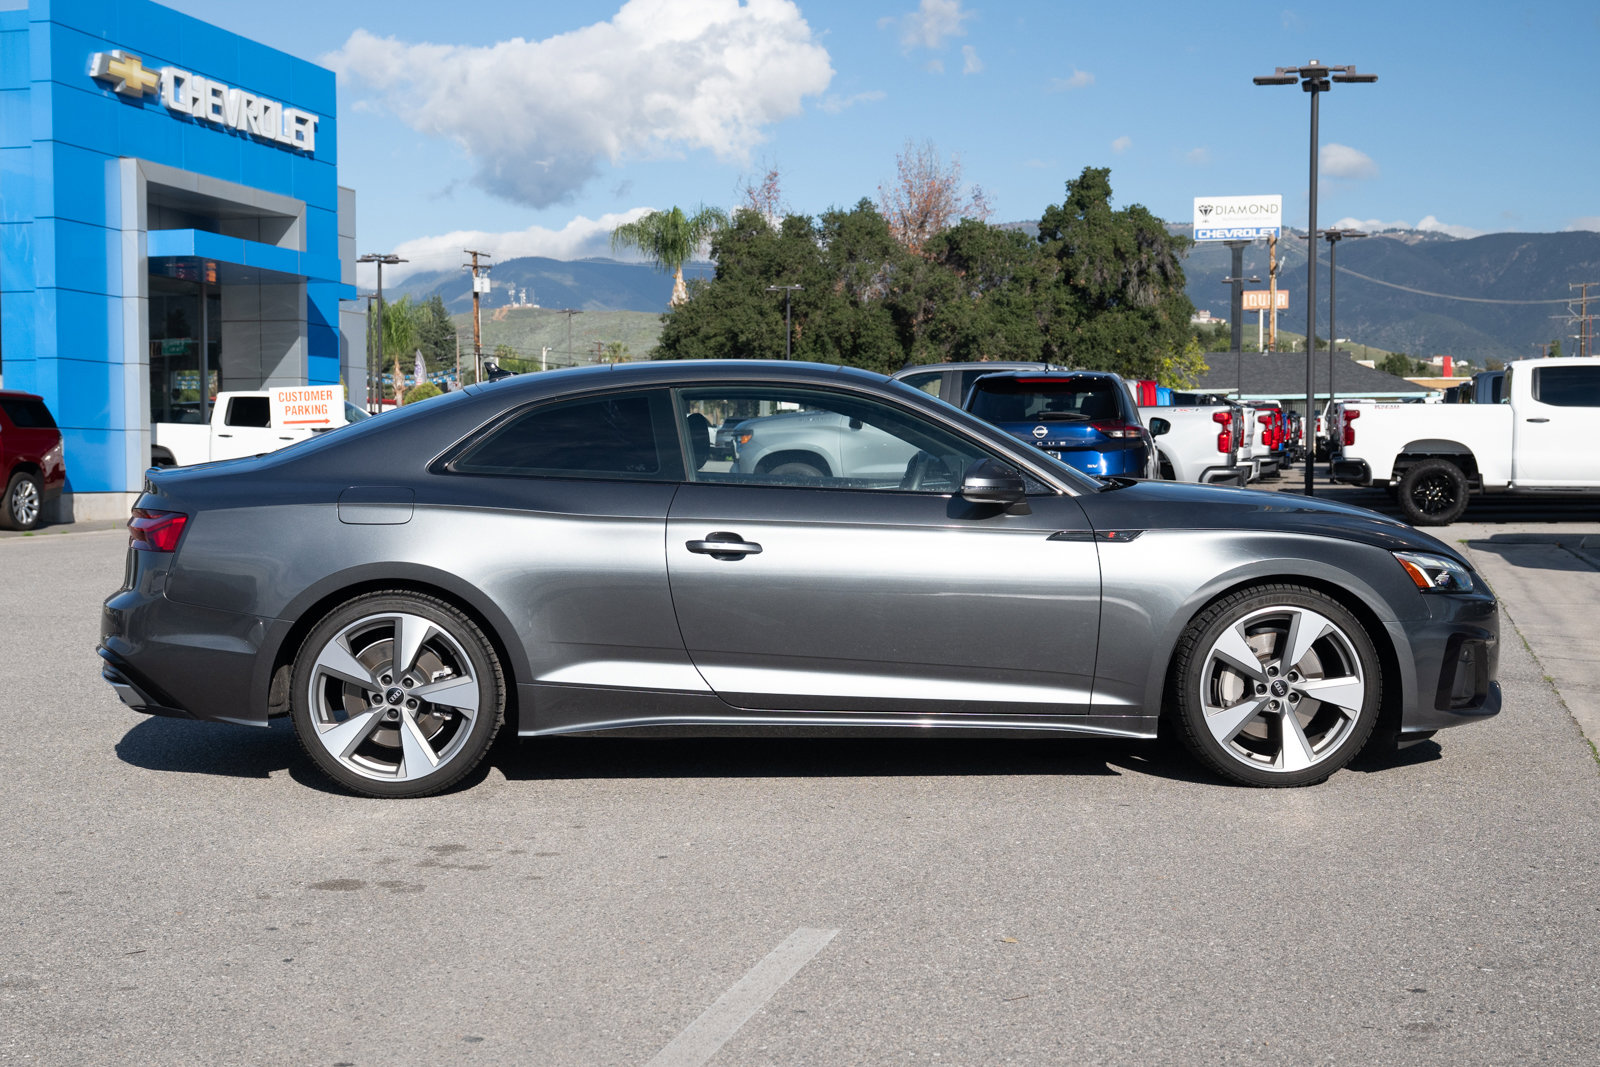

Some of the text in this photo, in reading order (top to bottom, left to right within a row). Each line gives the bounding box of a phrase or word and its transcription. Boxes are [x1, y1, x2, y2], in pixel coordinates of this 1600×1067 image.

[160, 67, 318, 152] CHEVROLET
[1215, 204, 1279, 215] DIAMOND
[1197, 228, 1277, 238] CHEVROLET
[1243, 293, 1286, 307] IQUR
[278, 390, 333, 402] CUSTOMER
[285, 404, 328, 416] PARKING
